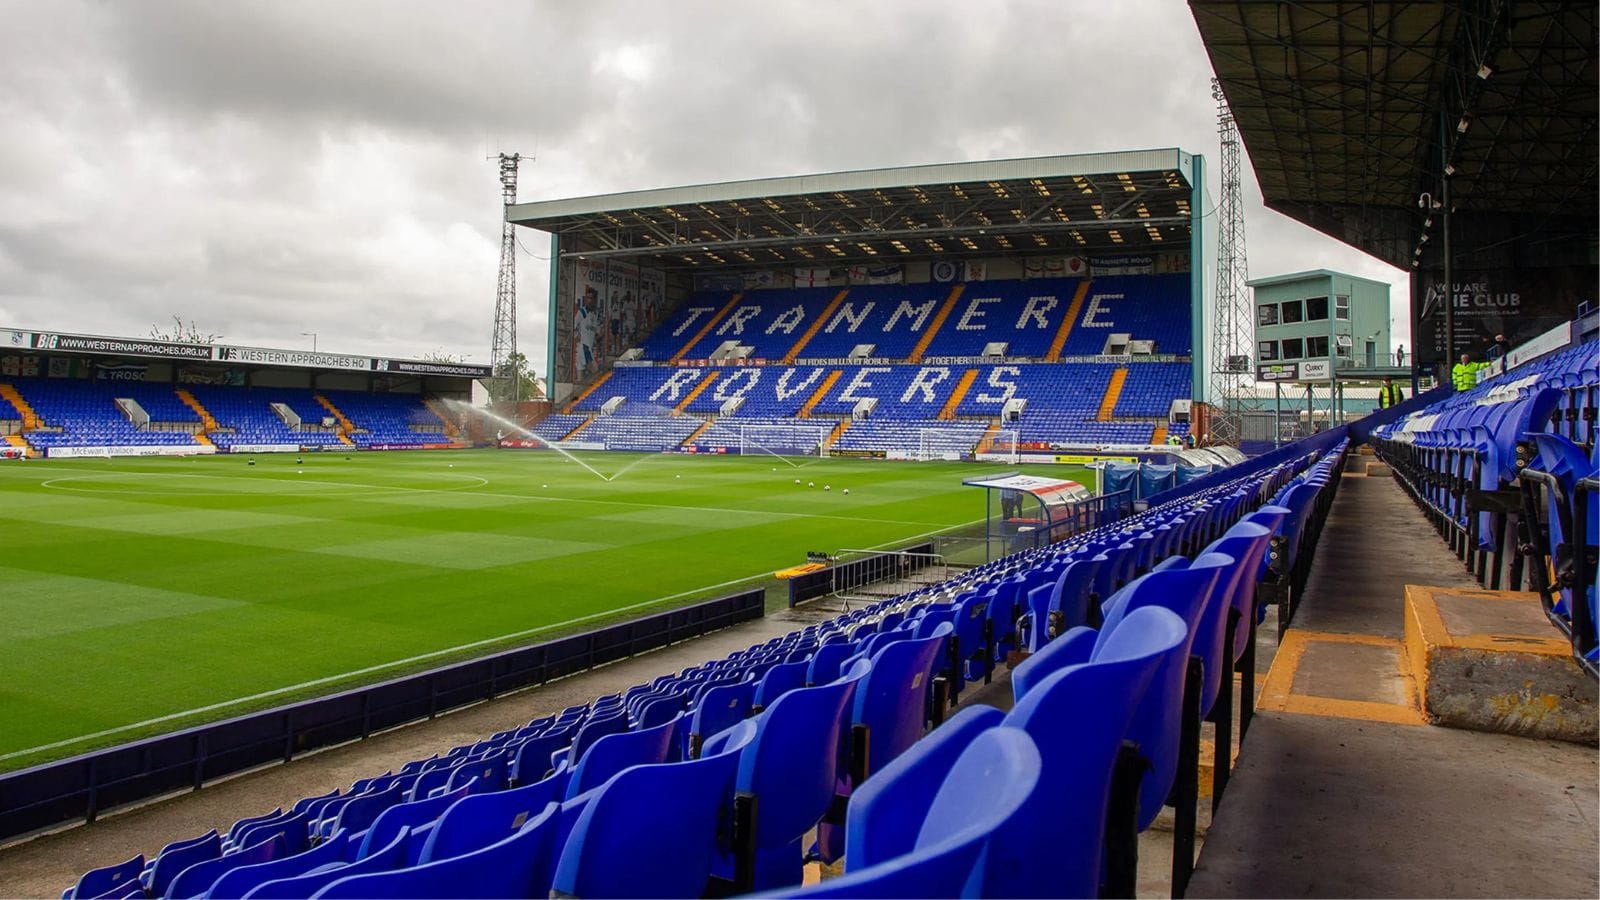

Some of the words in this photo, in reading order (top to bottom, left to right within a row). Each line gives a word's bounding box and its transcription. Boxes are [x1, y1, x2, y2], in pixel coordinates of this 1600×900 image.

[1463, 283, 1488, 292] ARE
[1474, 293, 1520, 307] CLUB
[672, 293, 1125, 337] TRANMERE
[61, 337, 209, 357] WWW.WESTERNAPPROACHES.ORG.UK
[241, 350, 289, 364] WESTERN
[291, 354, 350, 368] APPROACHES
[352, 359, 364, 368] HQ
[925, 356, 1005, 365] #TOGETHERSTRONGER
[649, 366, 1021, 403] ROVERS
